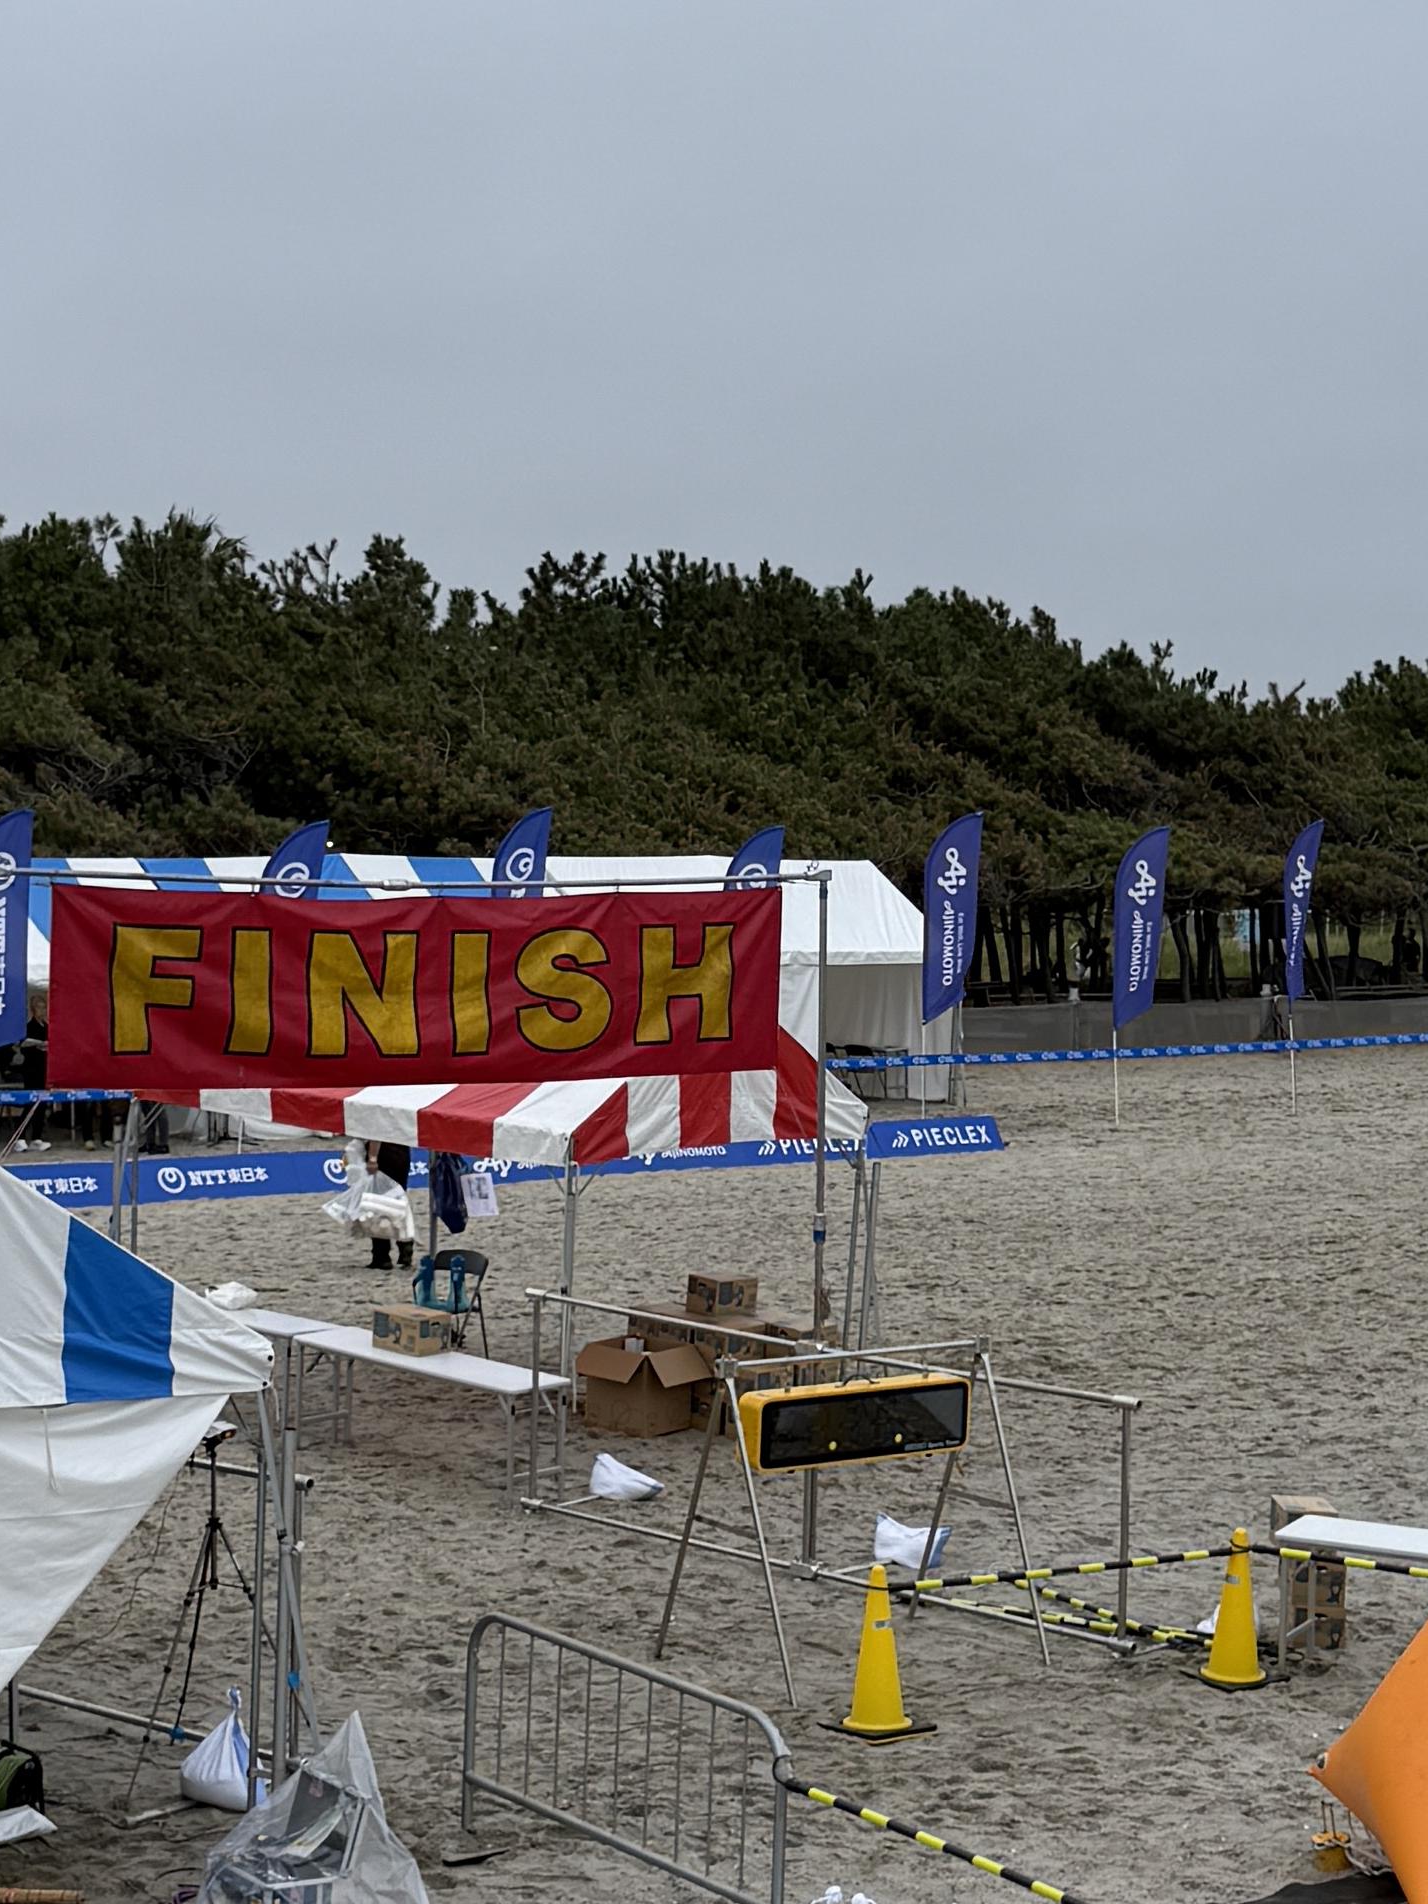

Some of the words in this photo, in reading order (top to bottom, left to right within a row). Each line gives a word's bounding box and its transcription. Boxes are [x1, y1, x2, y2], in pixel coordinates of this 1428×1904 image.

[942, 900, 954, 986] AJINOMOTO
[110, 922, 734, 1059] FINISH
[910, 1125, 992, 1147] PIECLEX
[27, 1176, 98, 1195] TT東日本
[187, 1166, 269, 1186] NTT東日本
